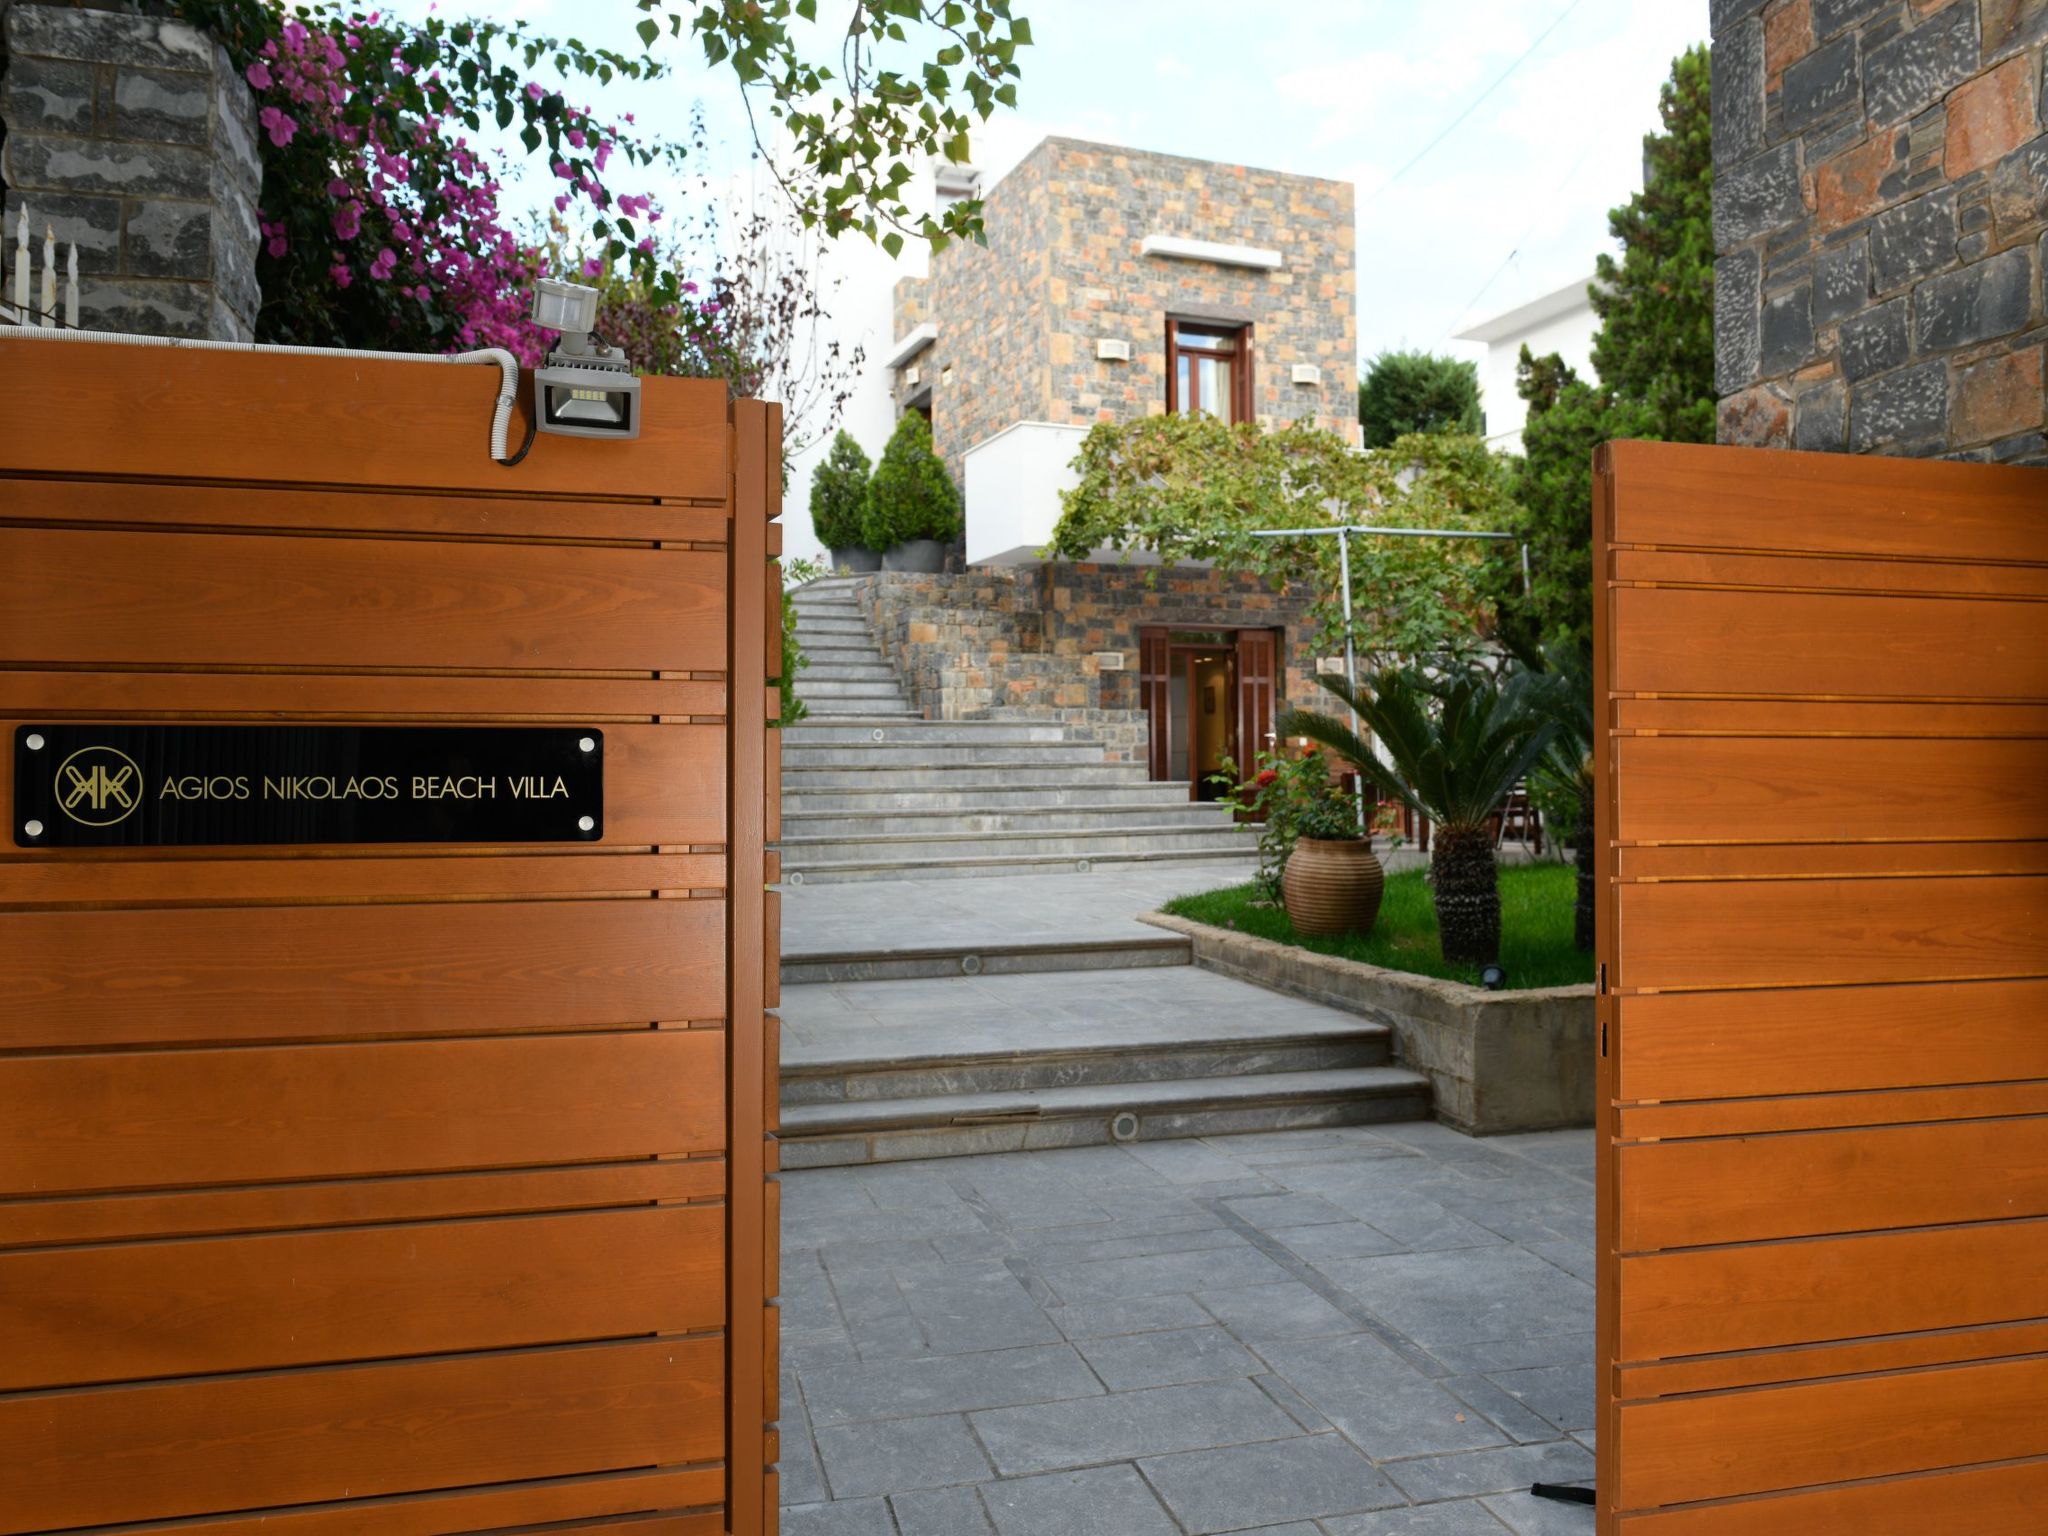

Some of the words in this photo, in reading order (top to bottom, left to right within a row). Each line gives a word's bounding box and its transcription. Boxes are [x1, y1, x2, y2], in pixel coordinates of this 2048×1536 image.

[159, 776, 249, 799] AGIOS
[264, 776, 398, 799] NIKOLAOS
[412, 776, 495, 798] BEACH
[507, 775, 569, 798] VILLA
